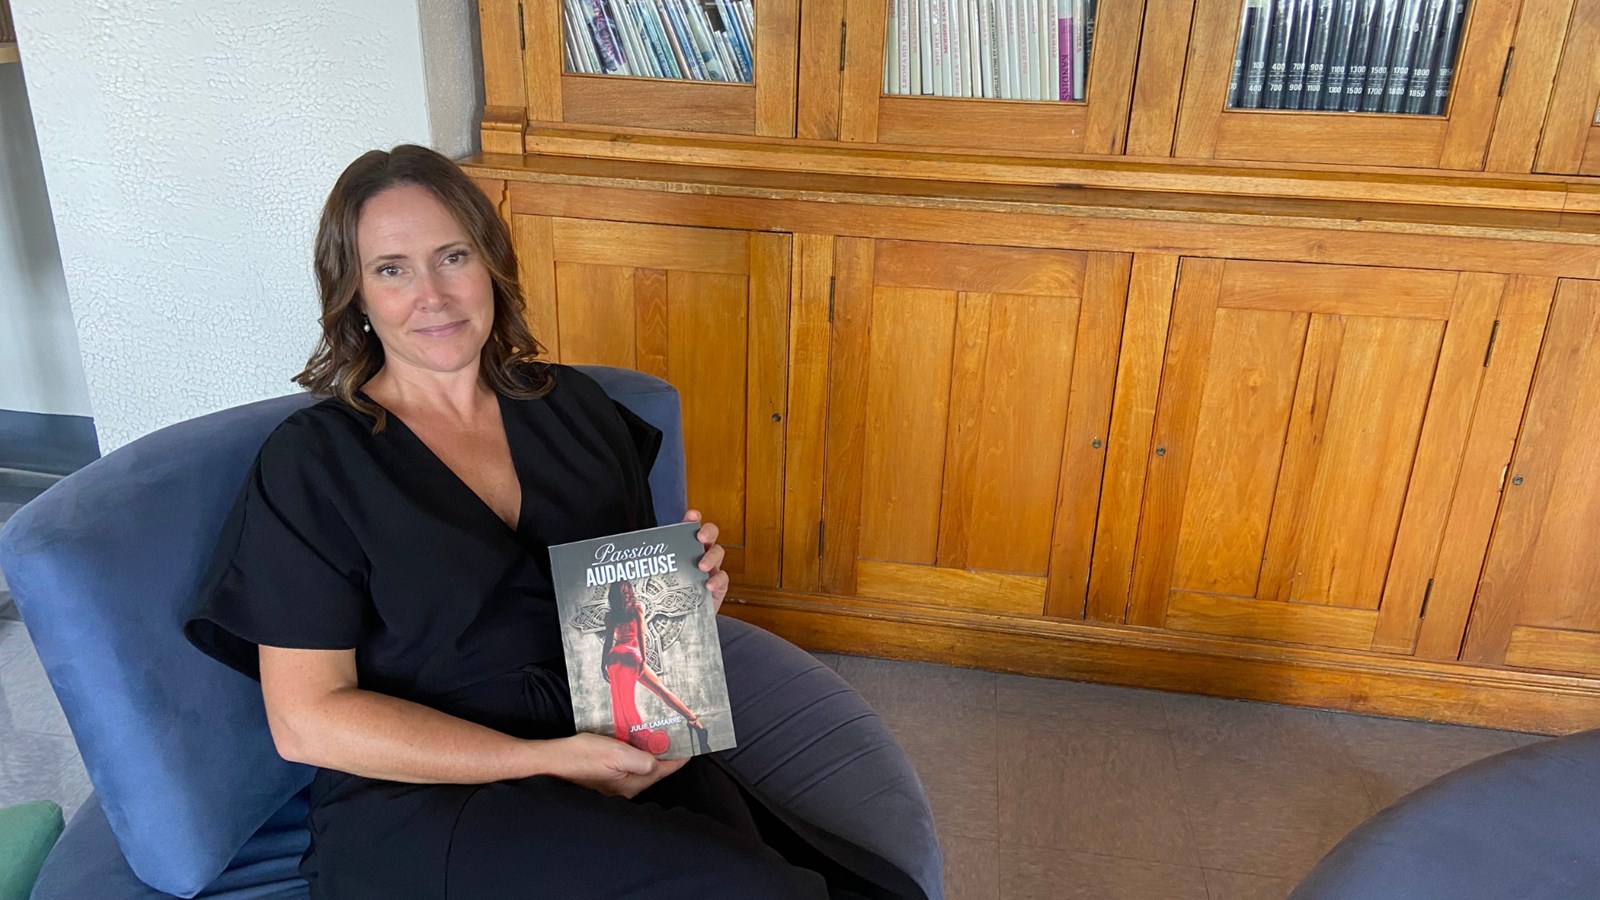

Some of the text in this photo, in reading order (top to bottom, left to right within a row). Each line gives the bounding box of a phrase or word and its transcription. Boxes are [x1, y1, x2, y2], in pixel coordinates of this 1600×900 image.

[592, 542, 668, 565] Passion
[586, 553, 678, 587] AUDACIEUSE
[630, 716, 682, 732] JULIE LAMARRE
